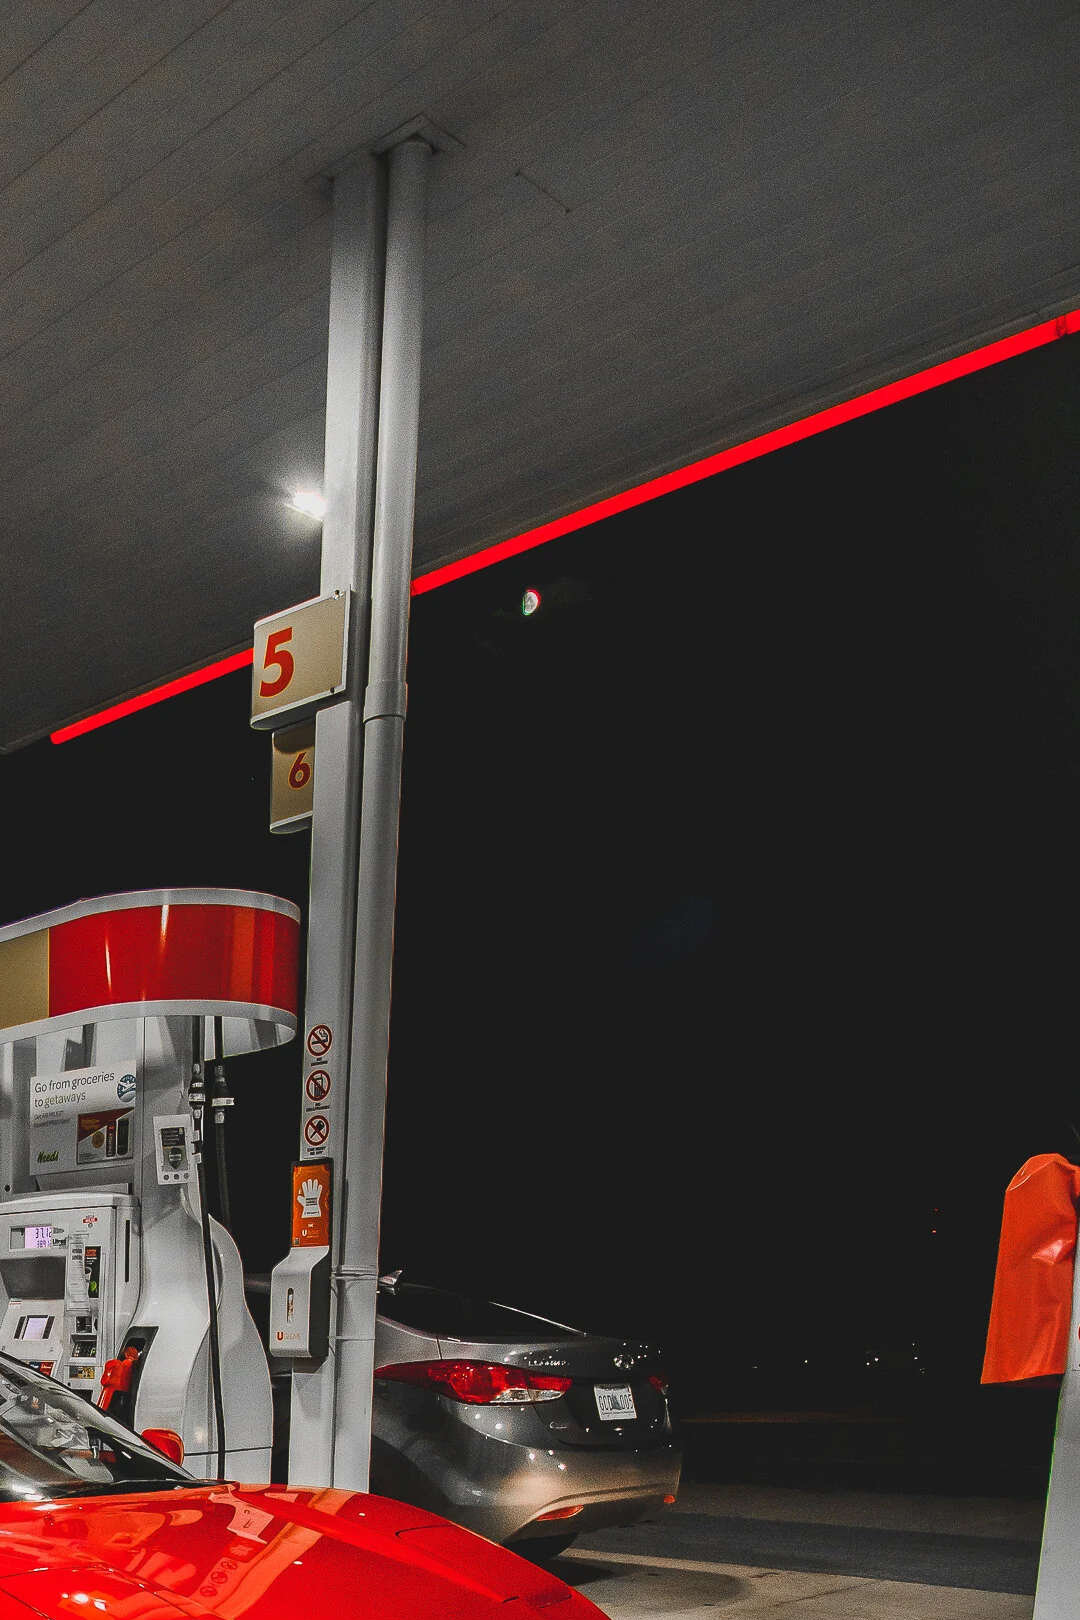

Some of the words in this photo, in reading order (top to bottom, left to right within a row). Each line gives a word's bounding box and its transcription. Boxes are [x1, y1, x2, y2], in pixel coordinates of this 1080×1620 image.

[259, 626, 295, 698] 5
[288, 751, 311, 789] 6
[34, 1082, 47, 1093] Go
[48, 1079, 71, 1091] from
[71, 1071, 115, 1090] groceries
[34, 1097, 44, 1107] to
[44, 1091, 86, 1108] getaways
